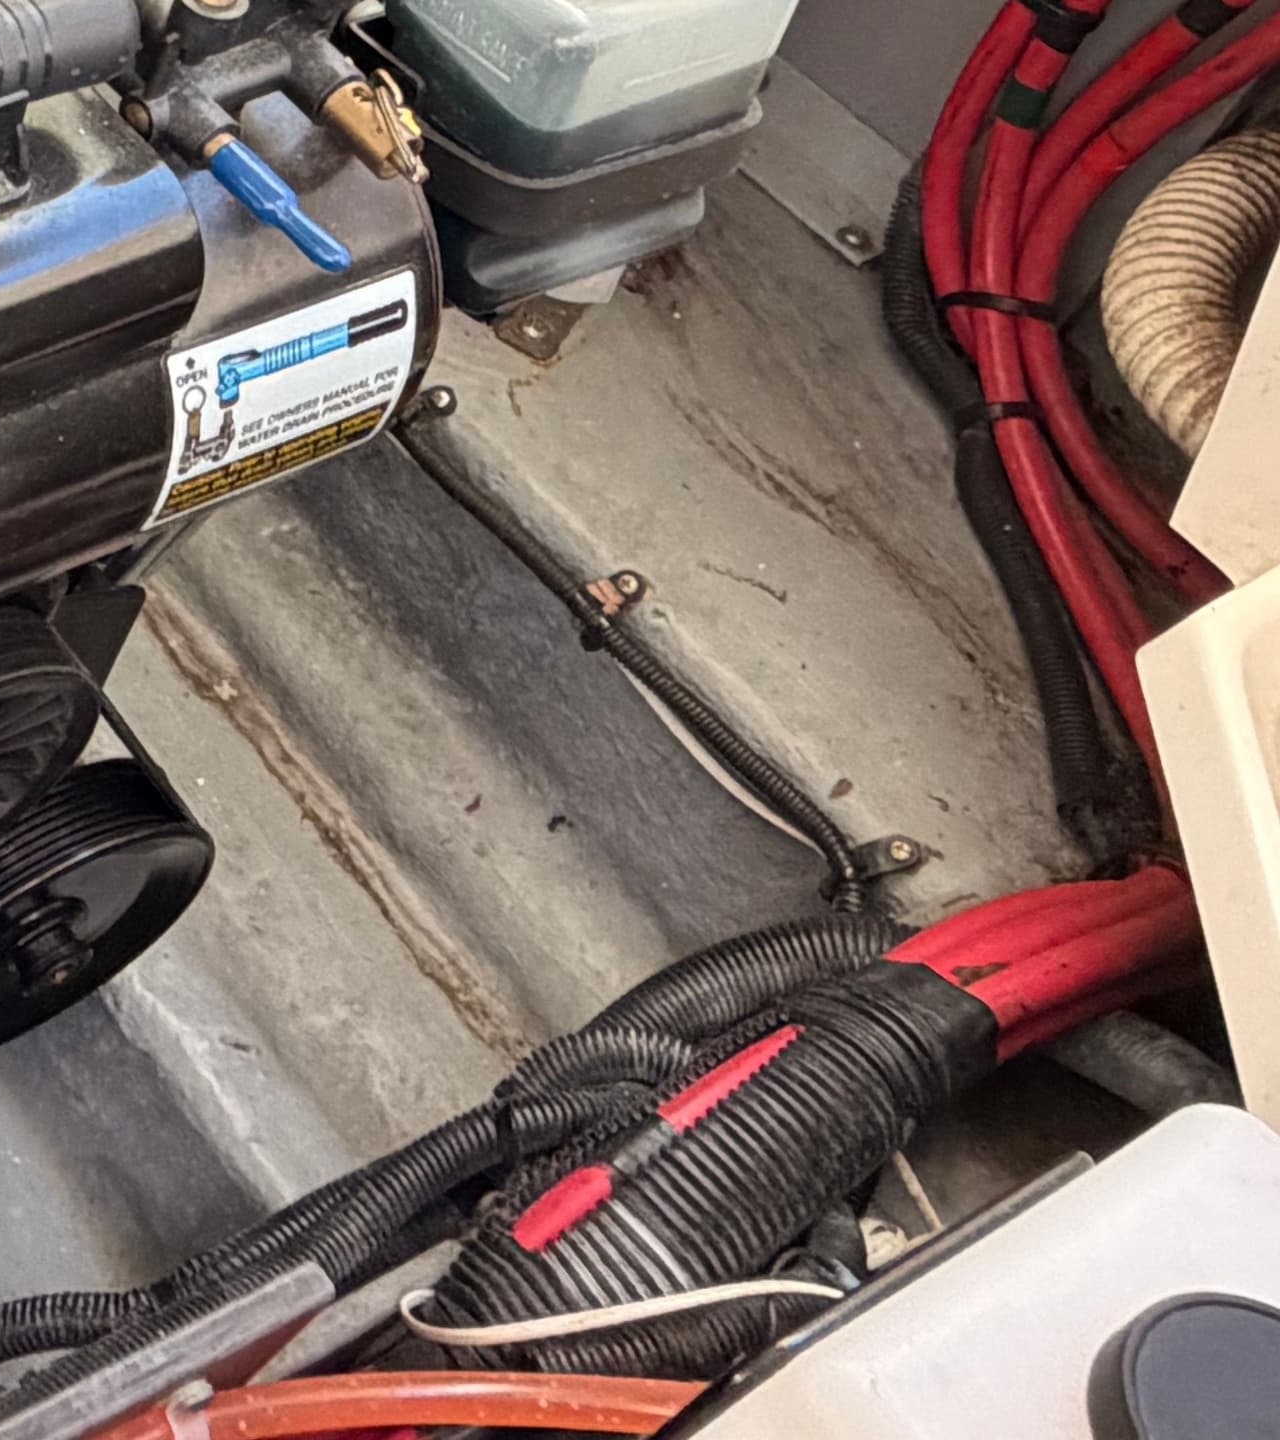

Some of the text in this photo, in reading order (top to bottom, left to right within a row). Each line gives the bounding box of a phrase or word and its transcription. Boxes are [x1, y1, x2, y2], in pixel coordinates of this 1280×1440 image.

[175, 367, 208, 389] OPEN
[240, 417, 265, 437] SEE
[321, 376, 370, 404] MANUAL
